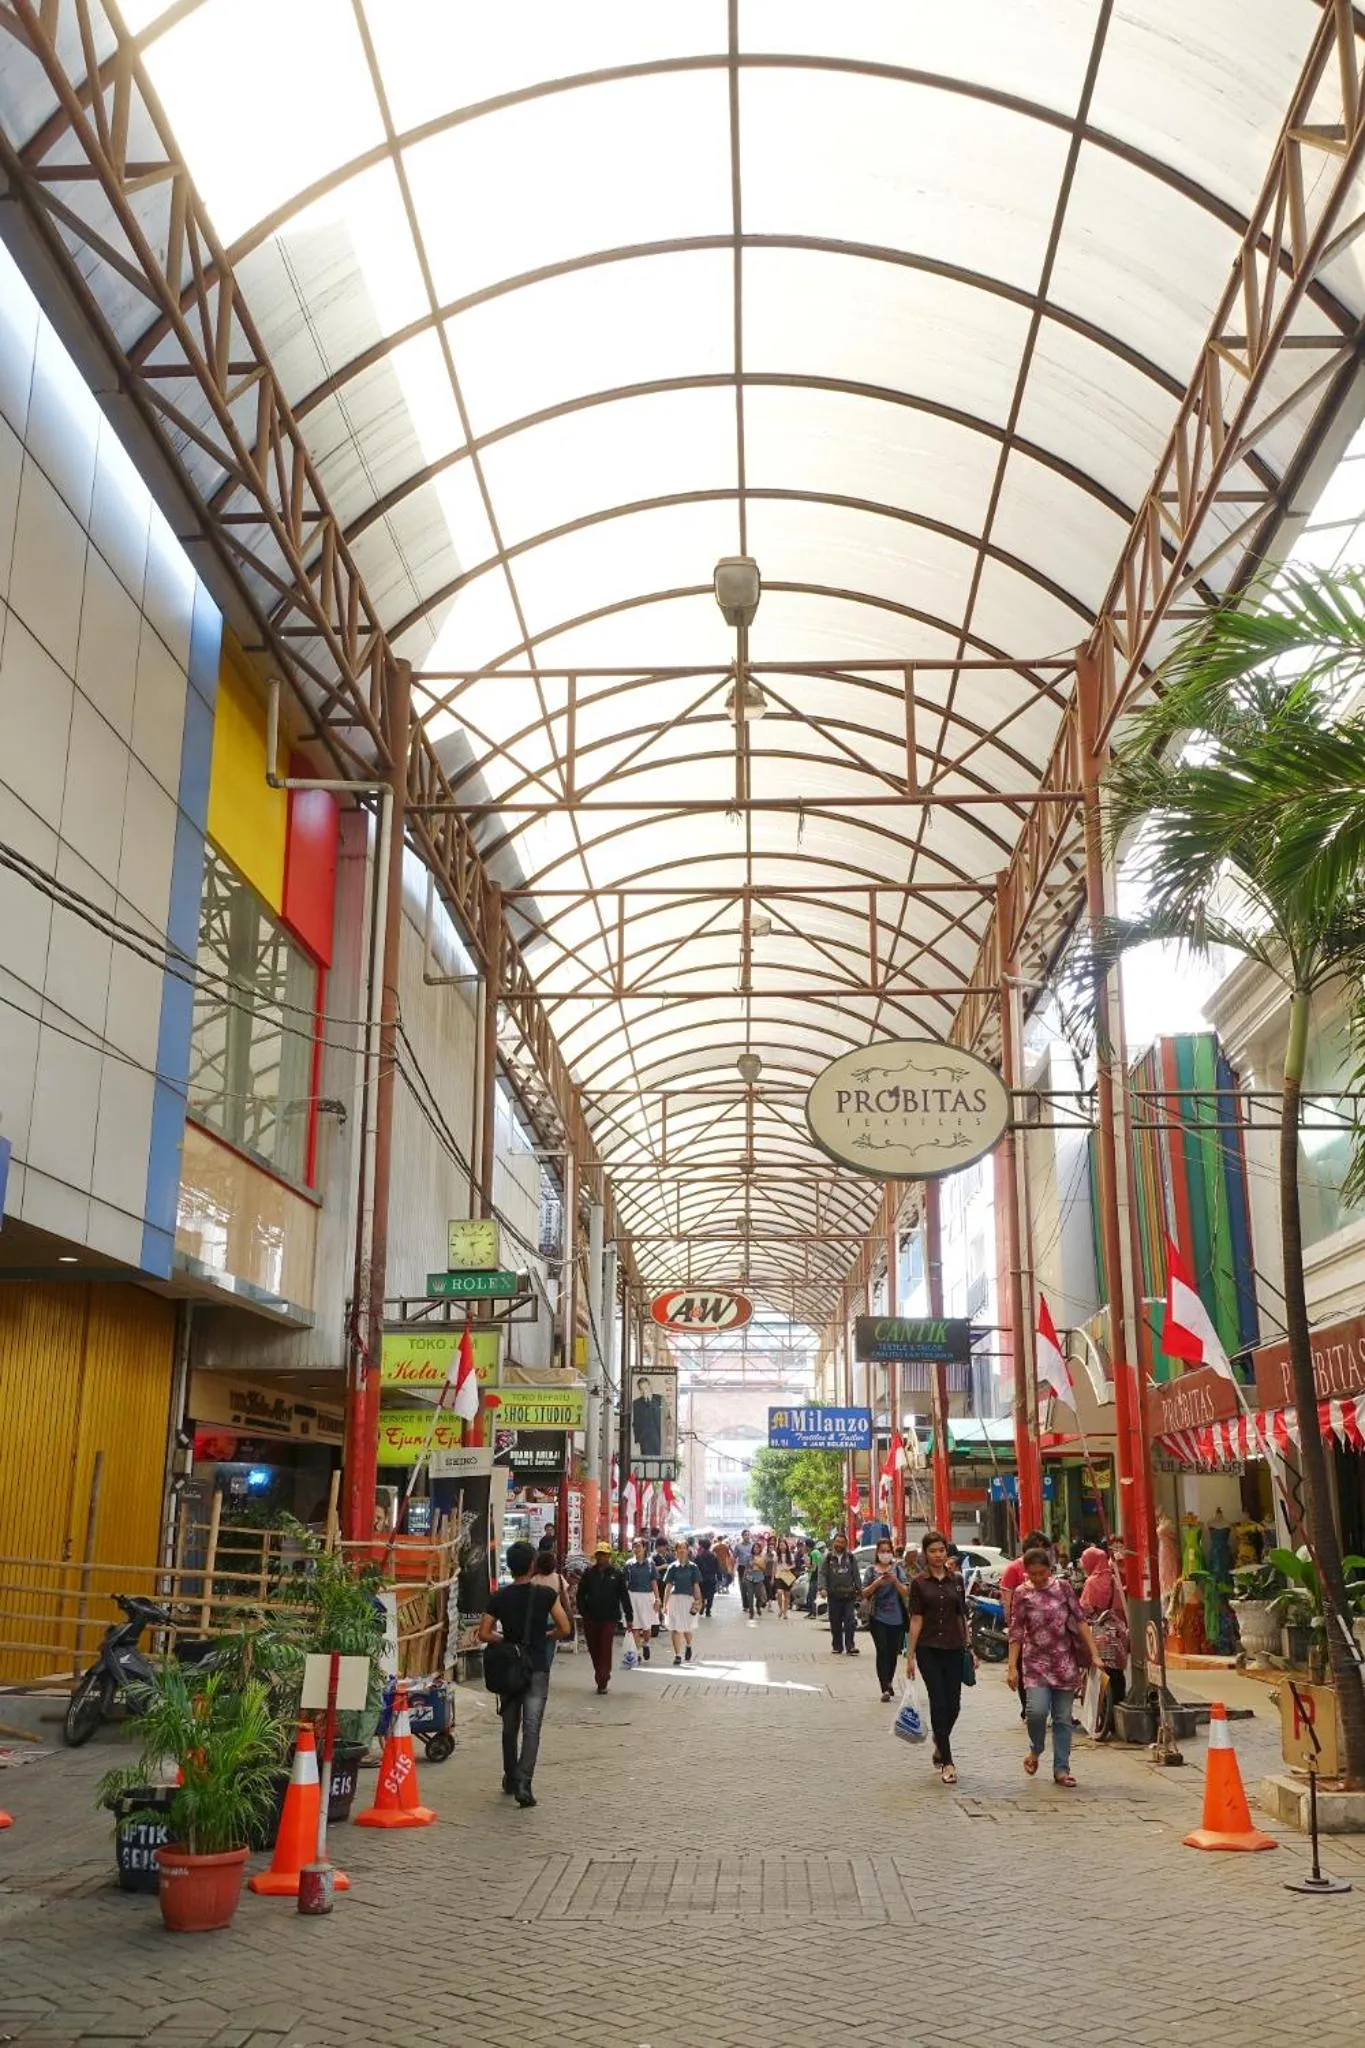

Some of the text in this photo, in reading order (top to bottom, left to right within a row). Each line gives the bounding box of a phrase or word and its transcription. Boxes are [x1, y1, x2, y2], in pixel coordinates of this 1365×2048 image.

[835, 1087, 987, 1114] PROBITAS
[846, 1117, 981, 1127] TEXTILES
[452, 1277, 512, 1291] ROLEX
[668, 1297, 733, 1324] A&W
[874, 1320, 951, 1343] CANTIK
[408, 1338, 446, 1350] TOKO
[504, 1406, 571, 1422] SHOE STUDIO
[1162, 1385, 1216, 1430] PROBITAS
[790, 1409, 869, 1432] Milanzo
[446, 1457, 478, 1467] SEIKO
[384, 1753, 412, 1794] SEIS
[331, 1776, 352, 1796] EIS
